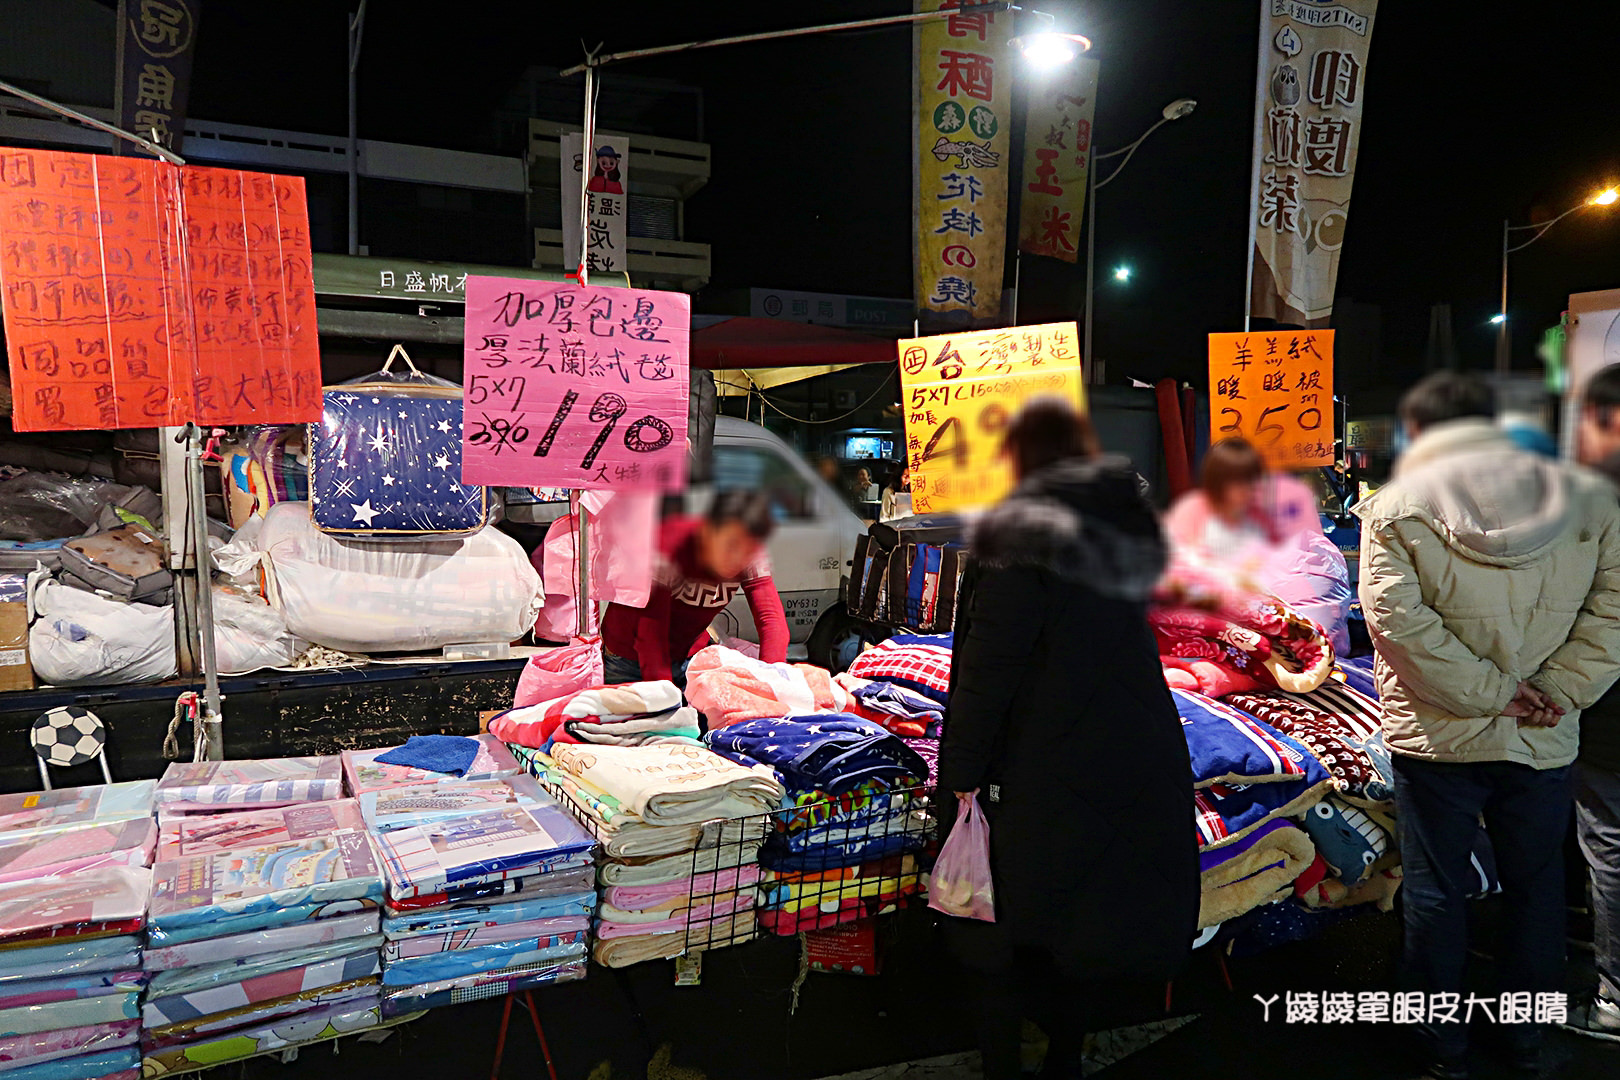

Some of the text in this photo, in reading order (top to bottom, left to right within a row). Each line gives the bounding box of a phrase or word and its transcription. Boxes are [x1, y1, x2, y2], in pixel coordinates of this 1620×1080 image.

[1028, 149, 1076, 252] 玉米
[493, 290, 671, 344] 加厚包邊
[855, 310, 888, 323] POST
[533, 389, 674, 470] 190
[909, 410, 937, 425] 加長
[1219, 403, 1321, 446] 250
